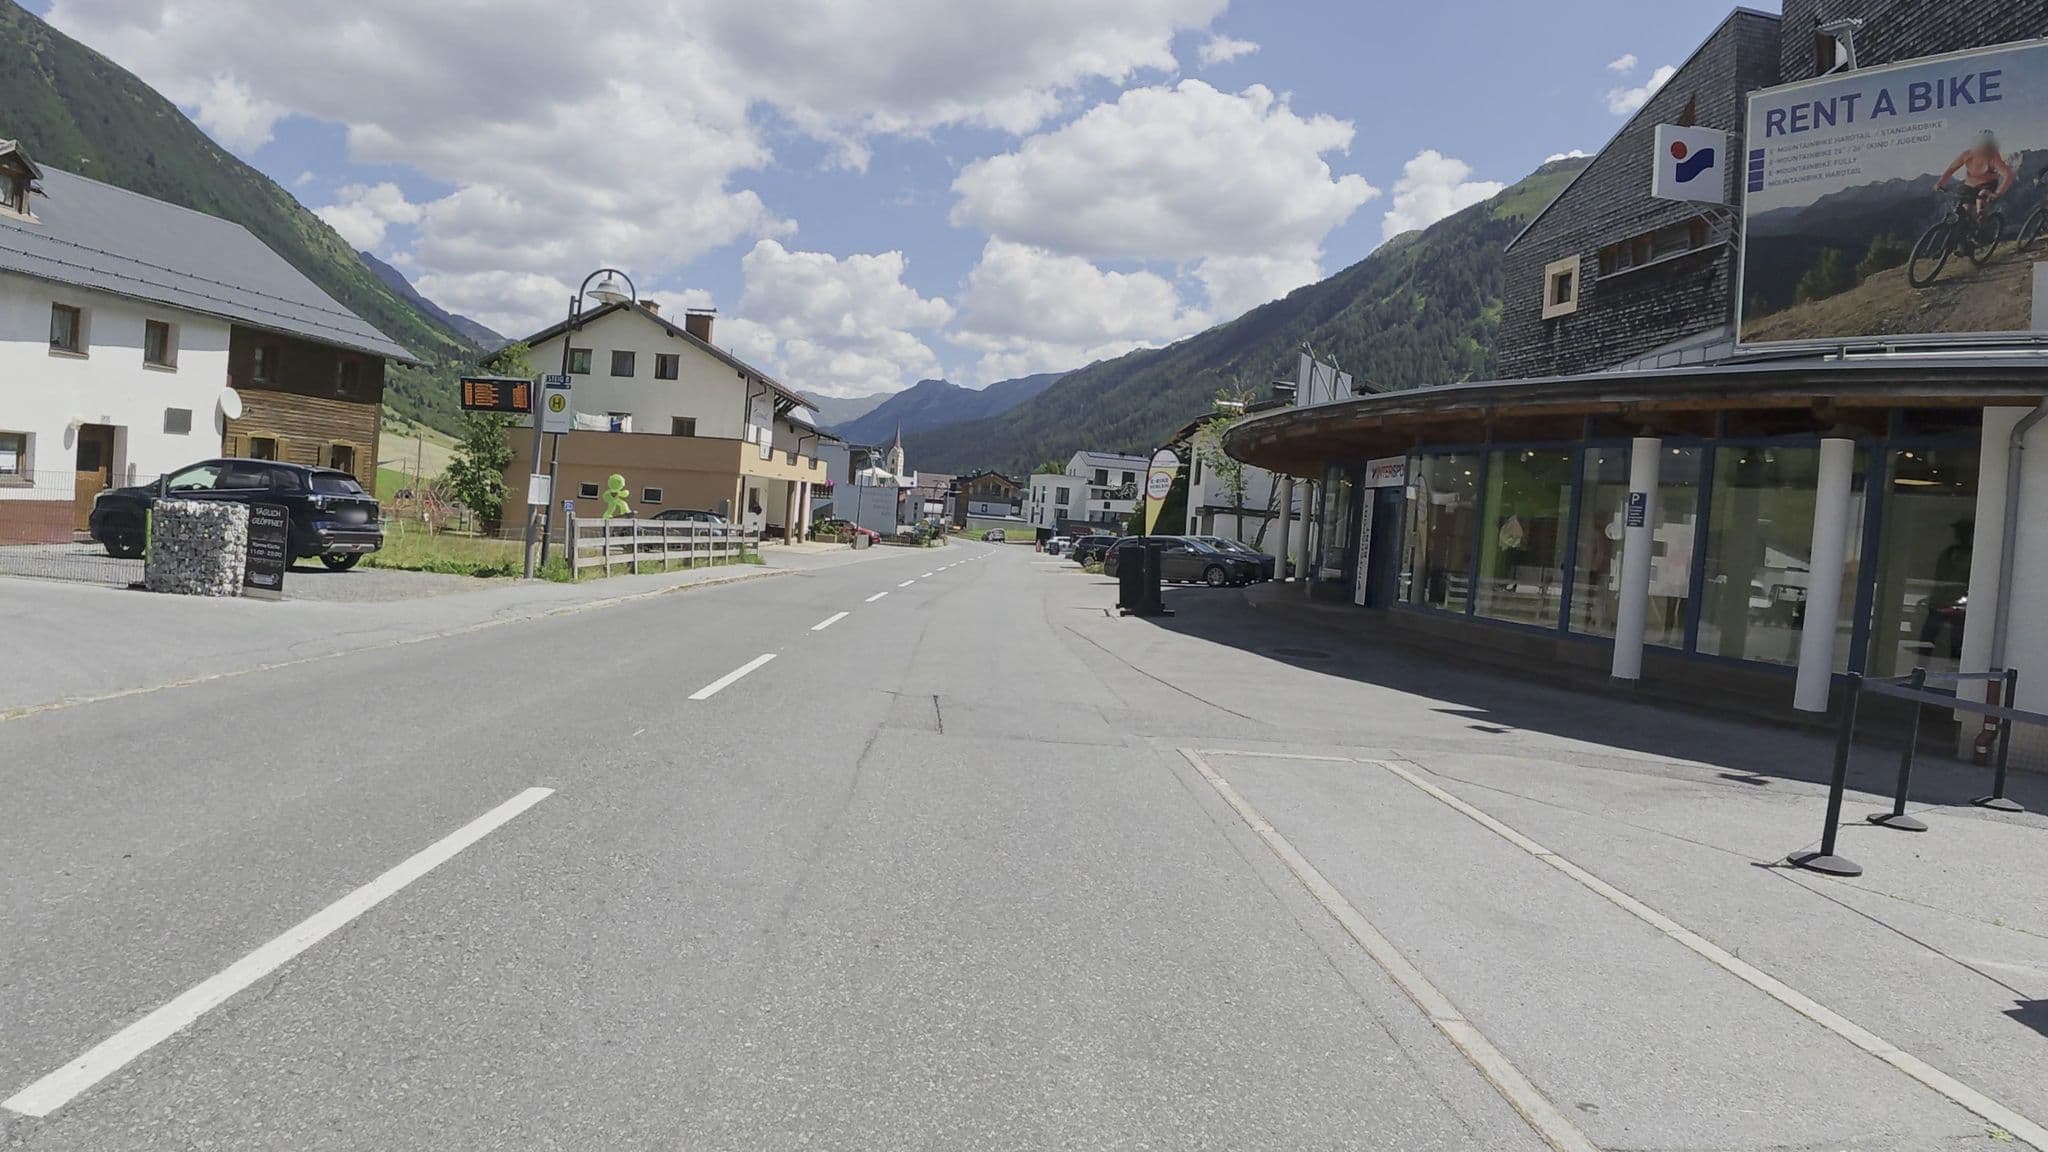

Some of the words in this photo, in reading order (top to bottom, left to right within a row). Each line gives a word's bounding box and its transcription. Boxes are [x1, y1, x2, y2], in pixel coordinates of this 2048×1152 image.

[1766, 92, 1862, 138] RENT
[1870, 88, 1897, 119] A
[1908, 69, 2003, 113] BIKE
[1880, 121, 1943, 137] STANDARDBIKE
[553, 397, 562, 409] H
[1632, 494, 1640, 505] P
